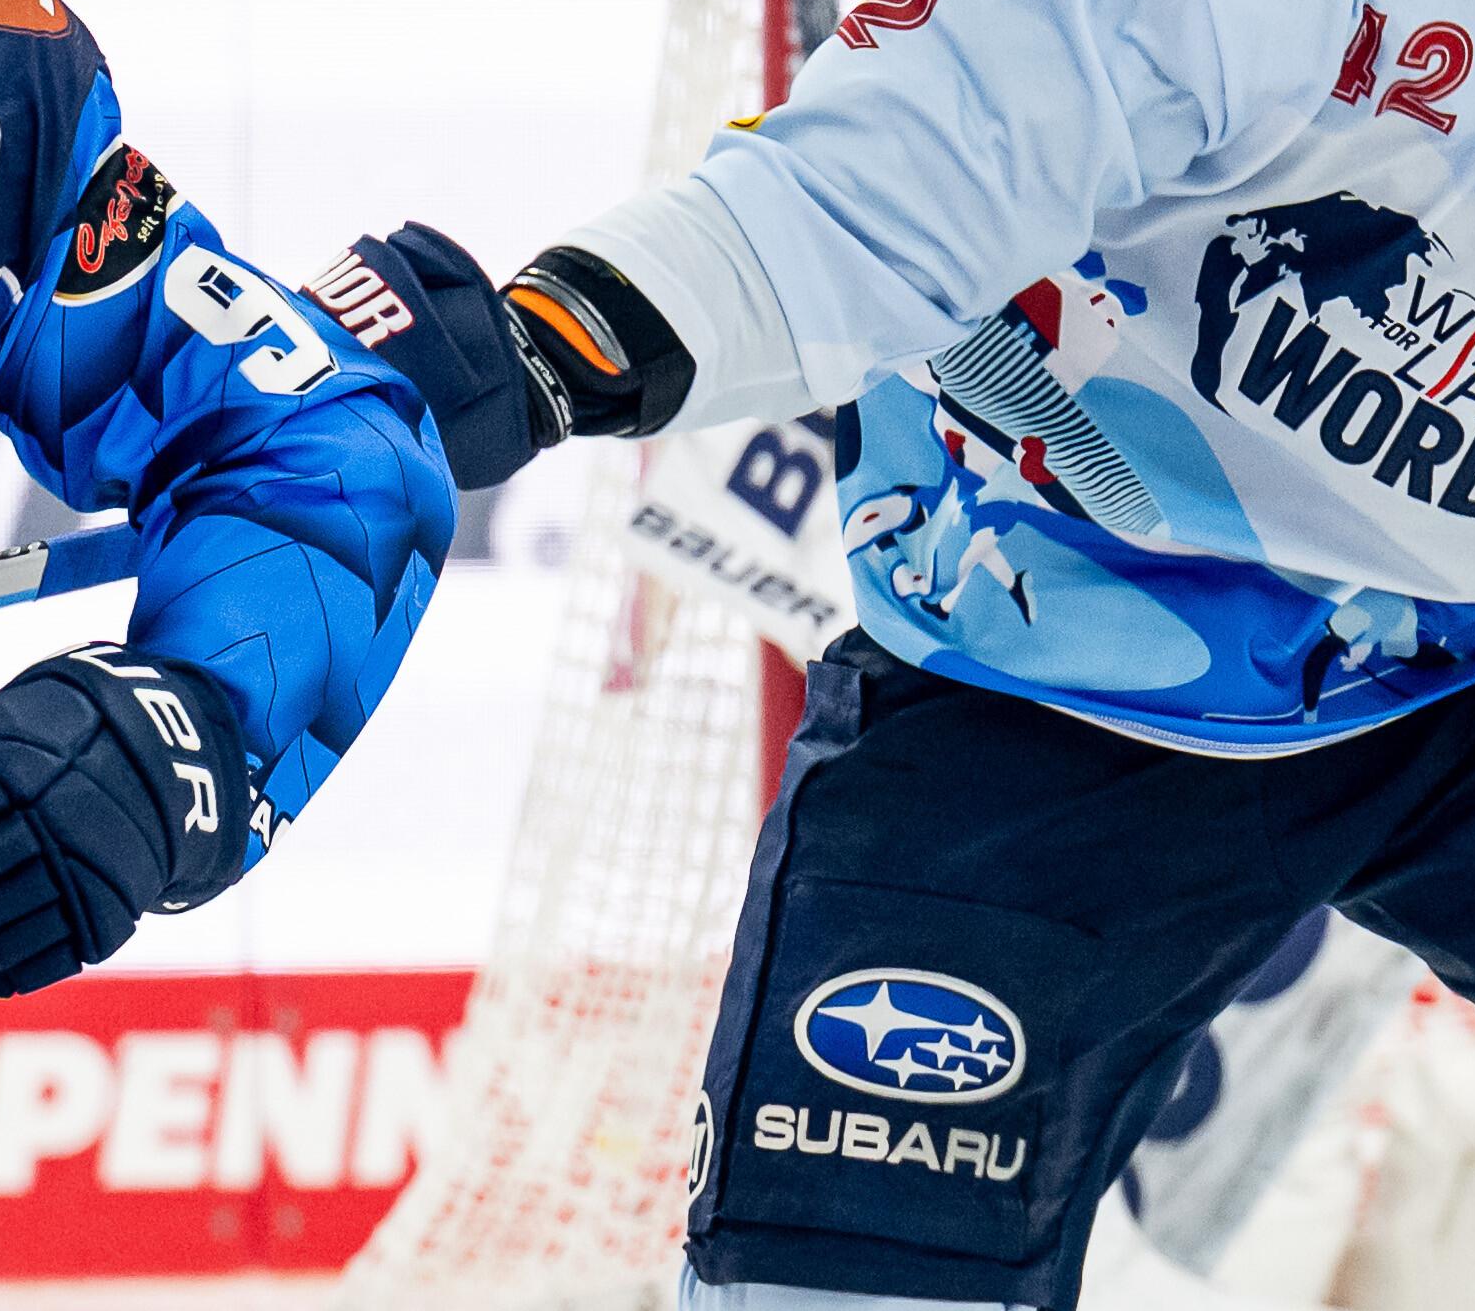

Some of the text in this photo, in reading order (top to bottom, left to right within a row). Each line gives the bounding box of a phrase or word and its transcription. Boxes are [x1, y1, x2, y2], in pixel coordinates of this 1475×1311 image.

[164, 244, 342, 397] 9
[1369, 312, 1423, 351] FOR
[752, 1102, 1027, 1183] SUBARU
